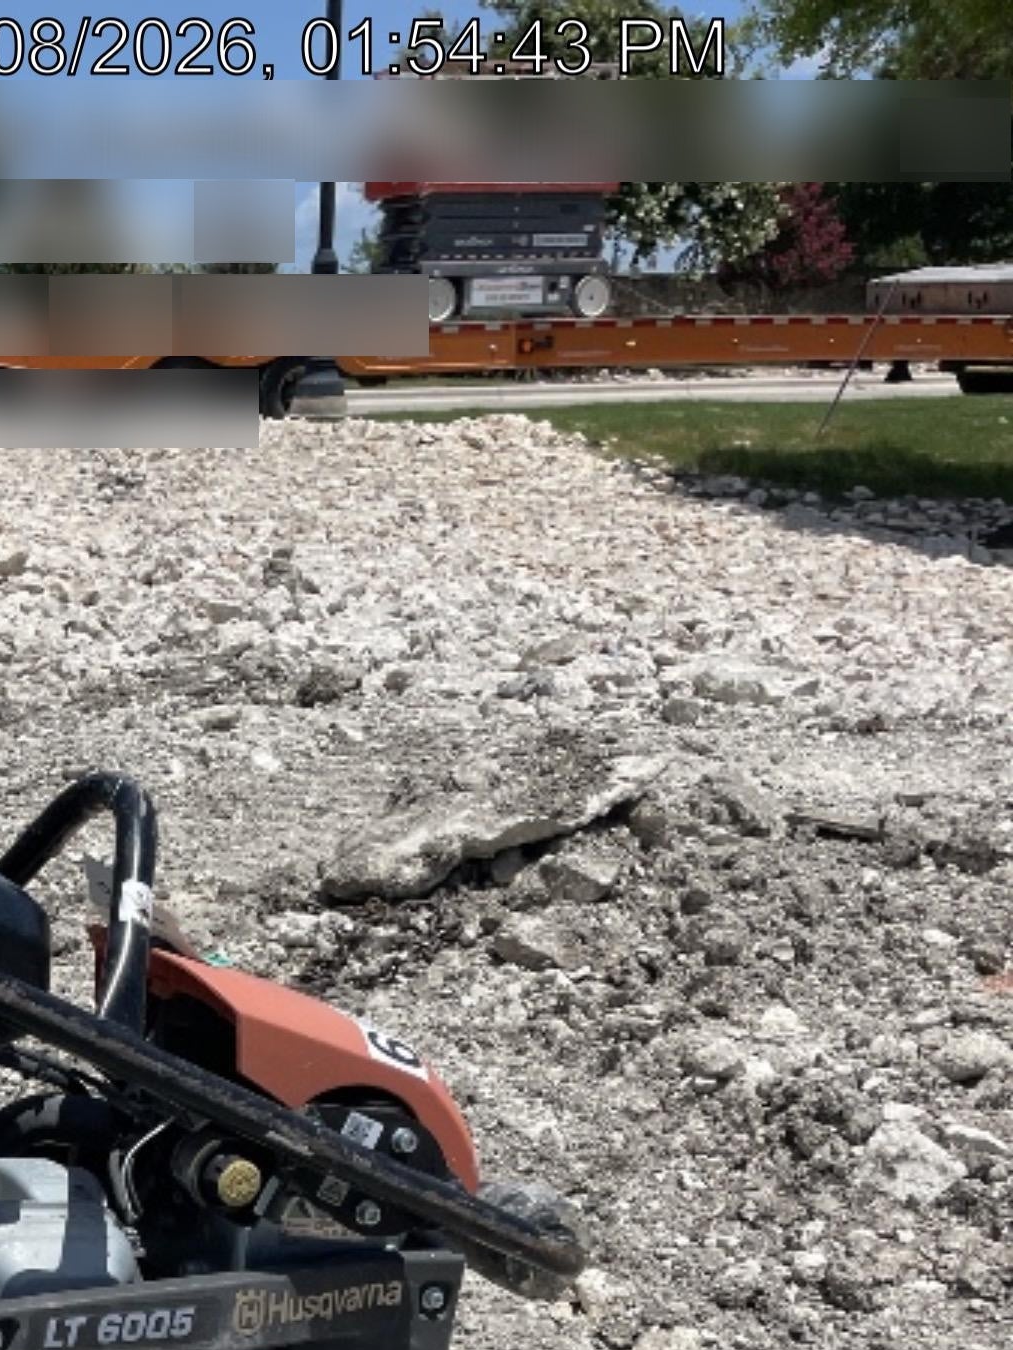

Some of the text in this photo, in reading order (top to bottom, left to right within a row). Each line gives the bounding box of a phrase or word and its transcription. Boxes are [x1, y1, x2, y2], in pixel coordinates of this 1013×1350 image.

[267, 1279, 403, 1326] Husqvarna
[44, 1306, 196, 1348] LT 6005
